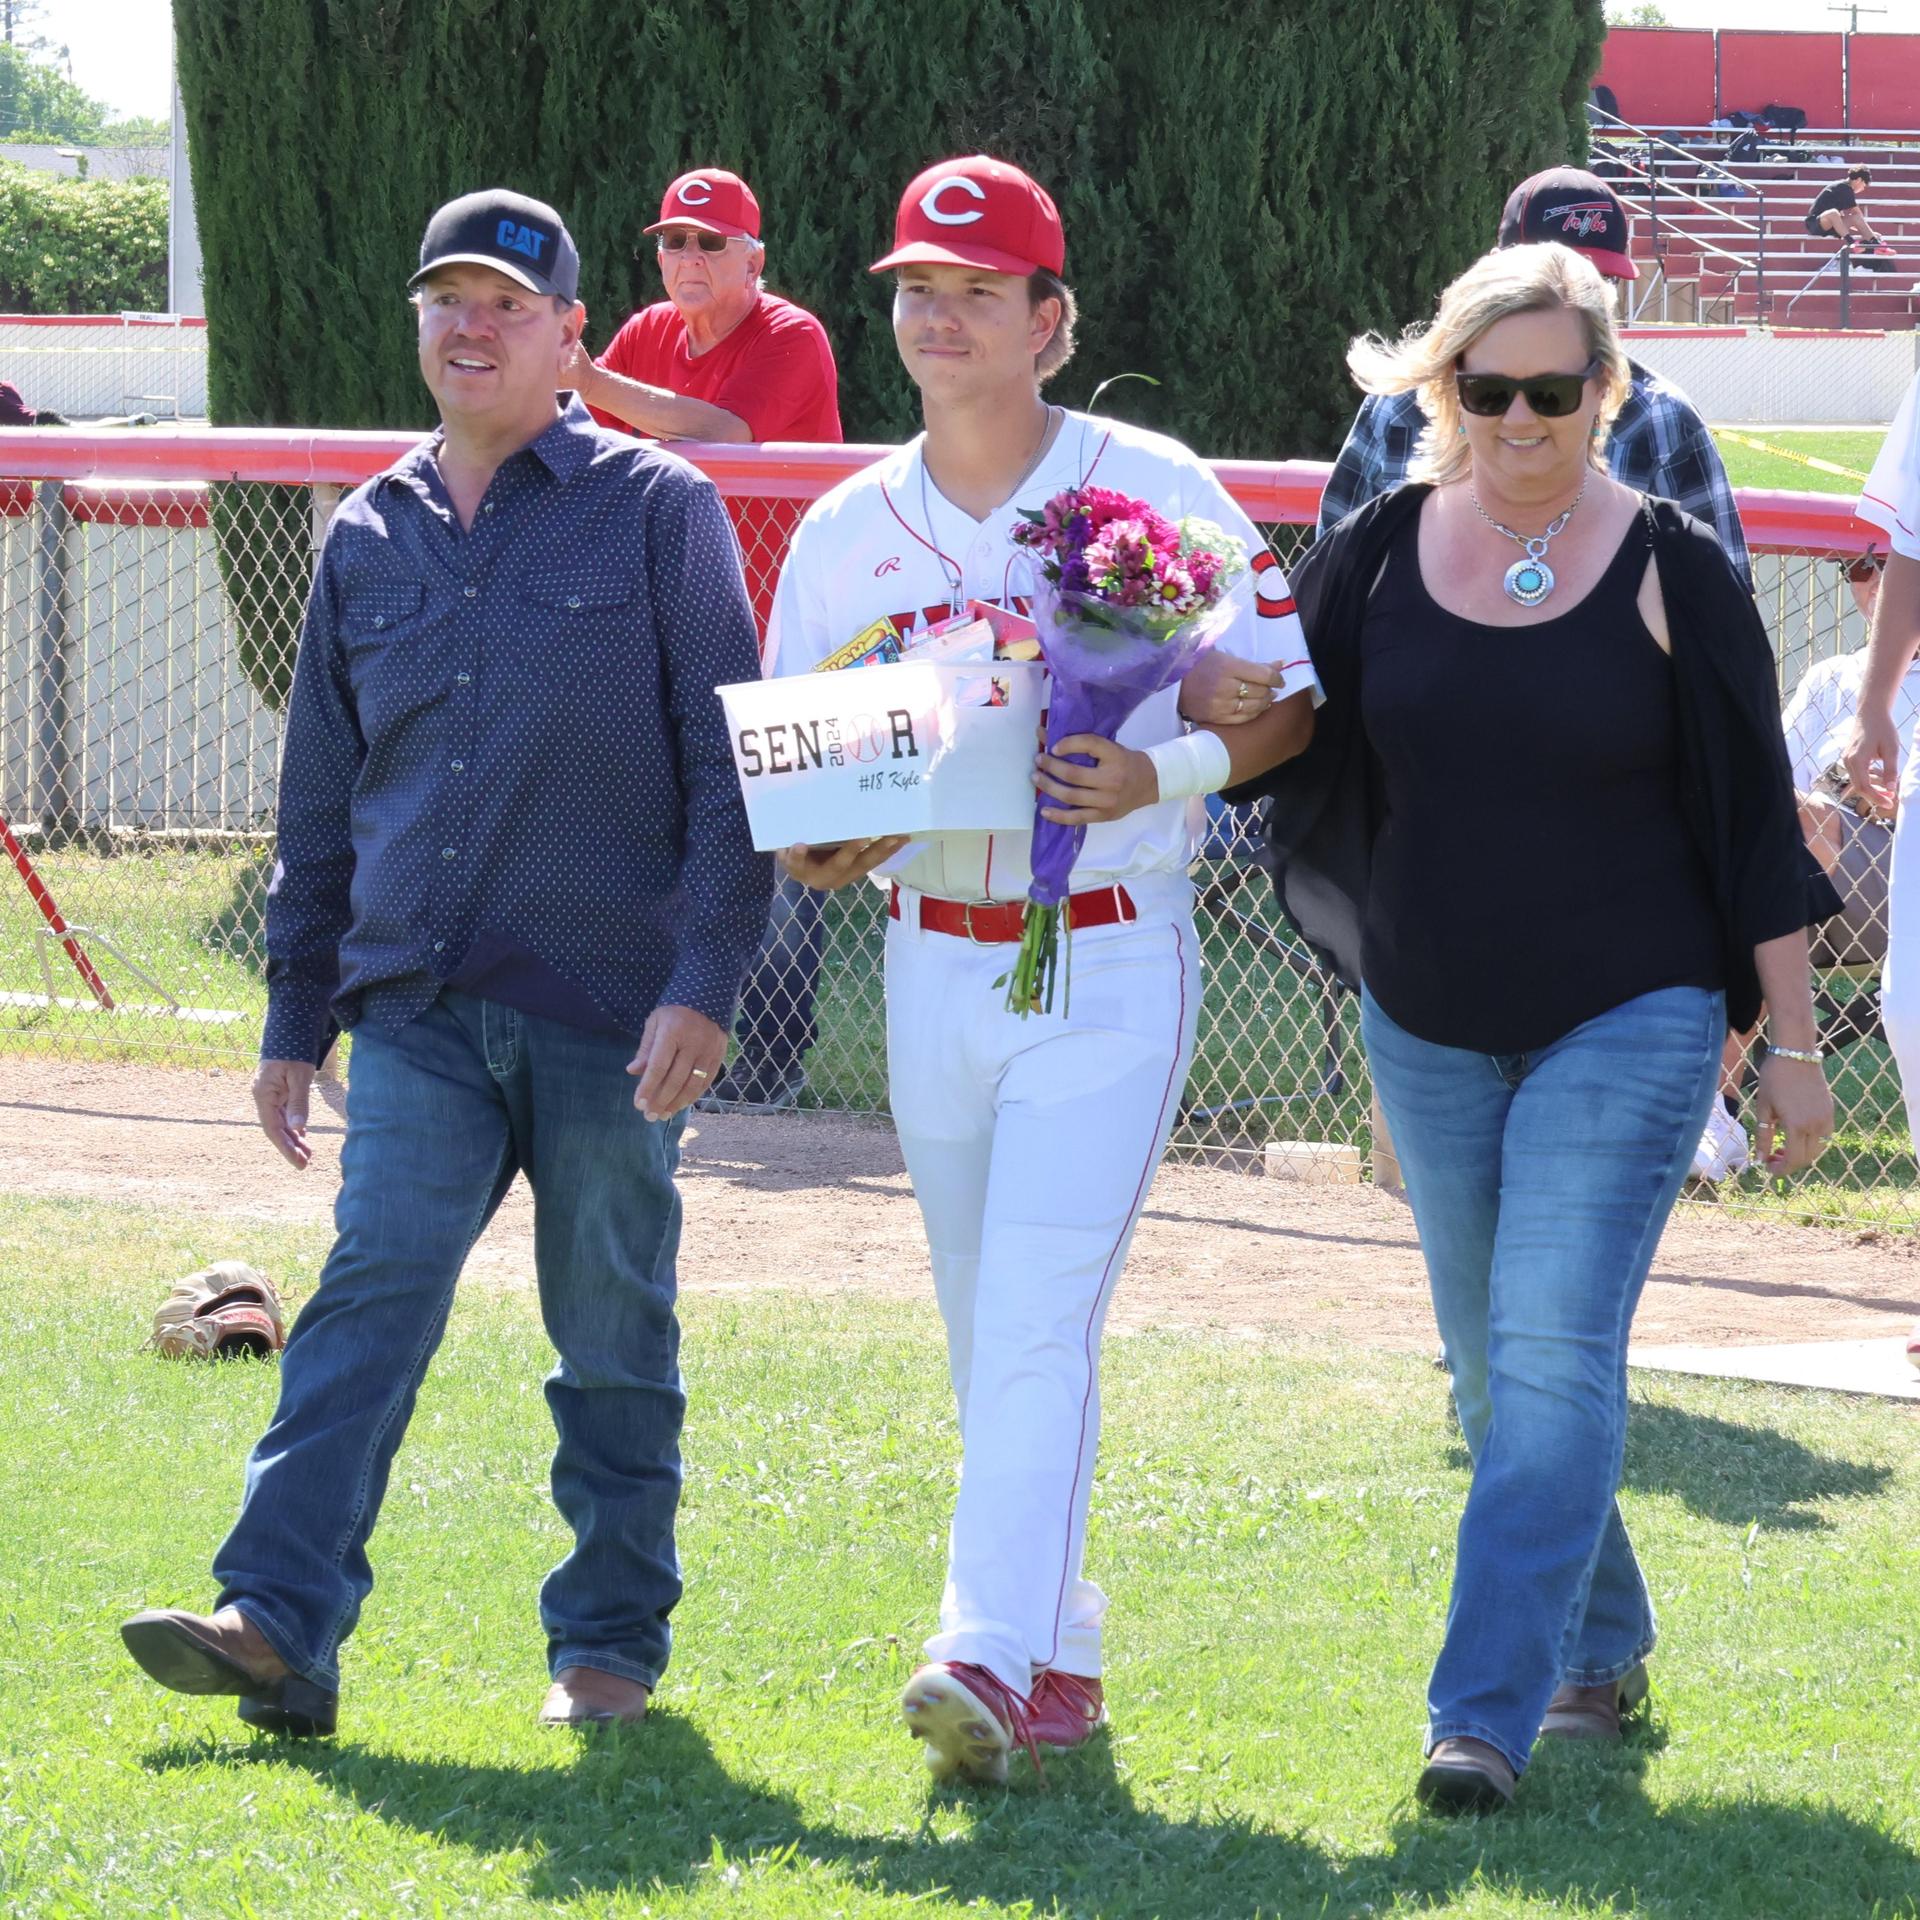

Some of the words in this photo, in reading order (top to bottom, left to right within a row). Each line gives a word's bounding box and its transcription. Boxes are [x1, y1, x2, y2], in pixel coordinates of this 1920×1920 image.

[677, 179, 713, 206] C
[919, 175, 986, 226] C
[496, 219, 545, 260] CAT
[825, 716, 845, 768] 2024
[858, 771, 884, 792] #18
[888, 770, 921, 792] Kyle
